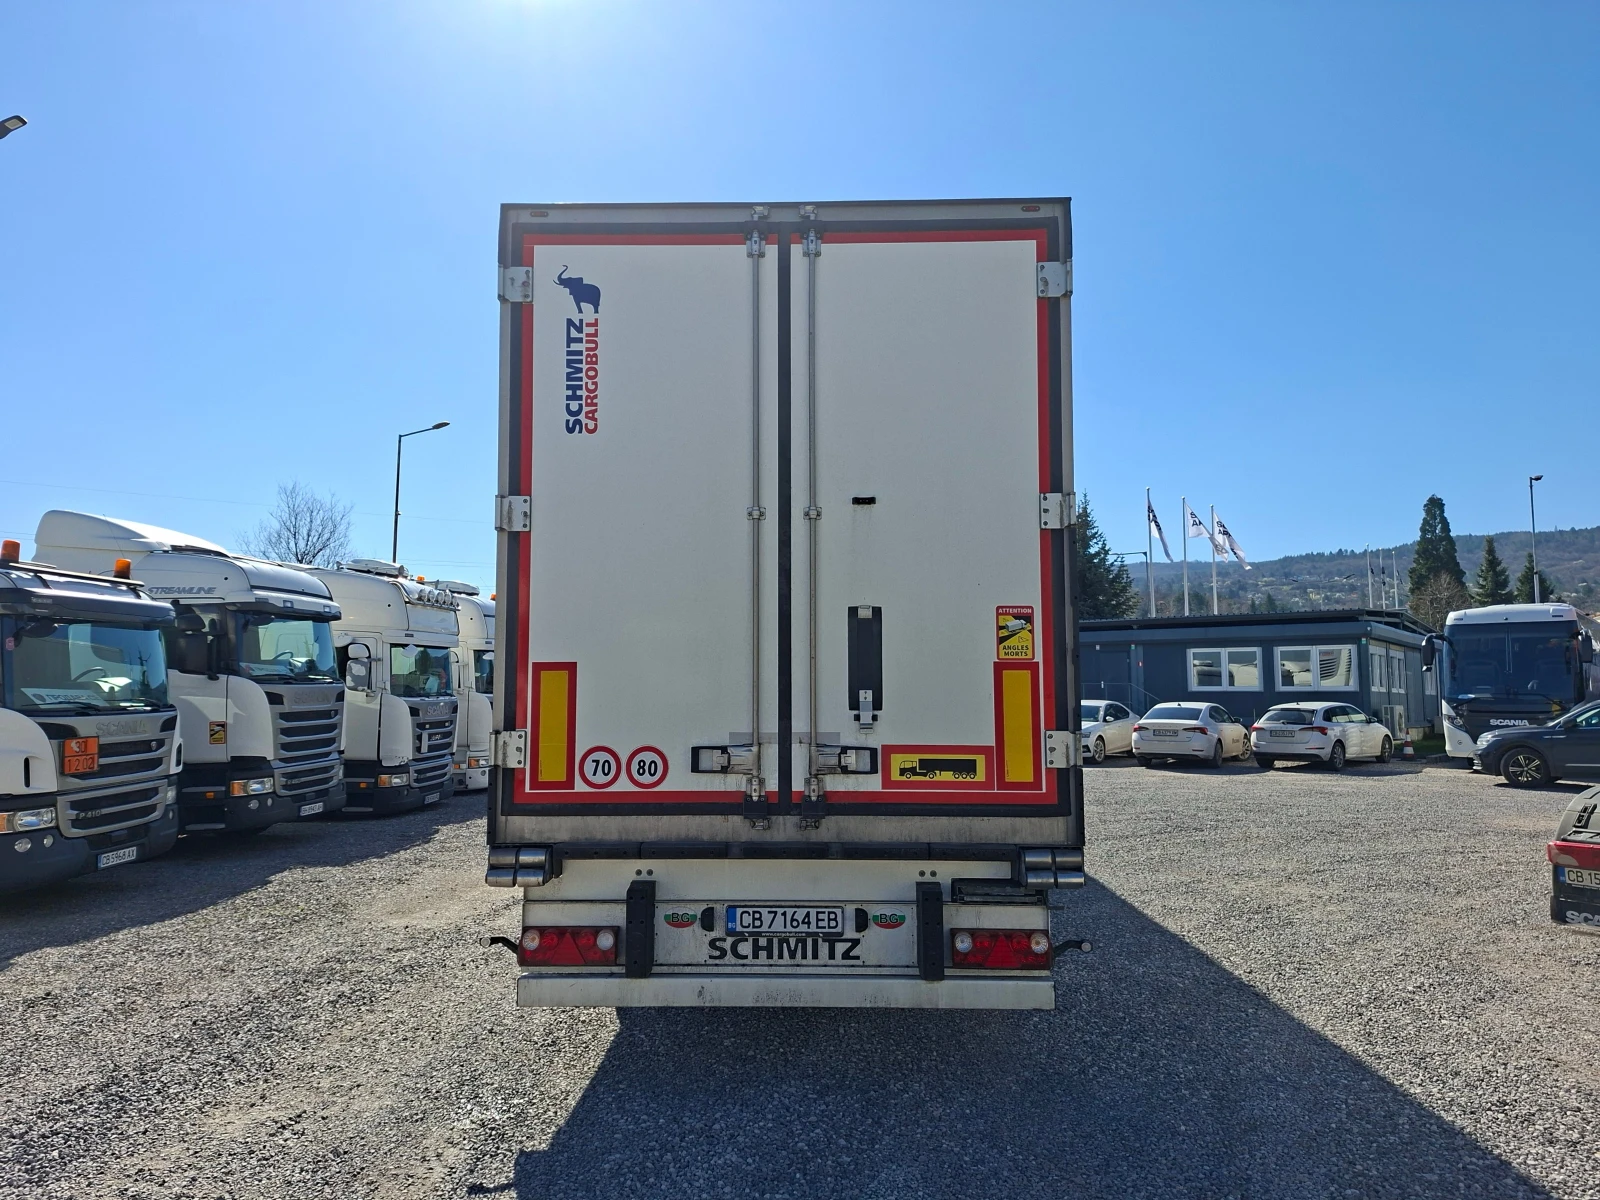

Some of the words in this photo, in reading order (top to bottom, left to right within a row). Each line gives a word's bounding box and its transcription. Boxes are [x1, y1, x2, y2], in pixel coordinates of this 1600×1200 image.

[565, 318, 583, 434] SCHMITZ
[584, 318, 599, 435] CARGOBULL
[148, 587, 216, 595] STREAMLINE
[427, 705, 449, 716] SCANIA
[96, 719, 147, 736] SCANIA
[1489, 718, 1530, 727] SCANIA
[591, 759, 612, 777] 70
[636, 759, 658, 777] 80
[86, 810, 101, 818] 410
[671, 912, 690, 924] BG
[879, 913, 899, 925] BG
[708, 937, 861, 961] SCHMITZ
